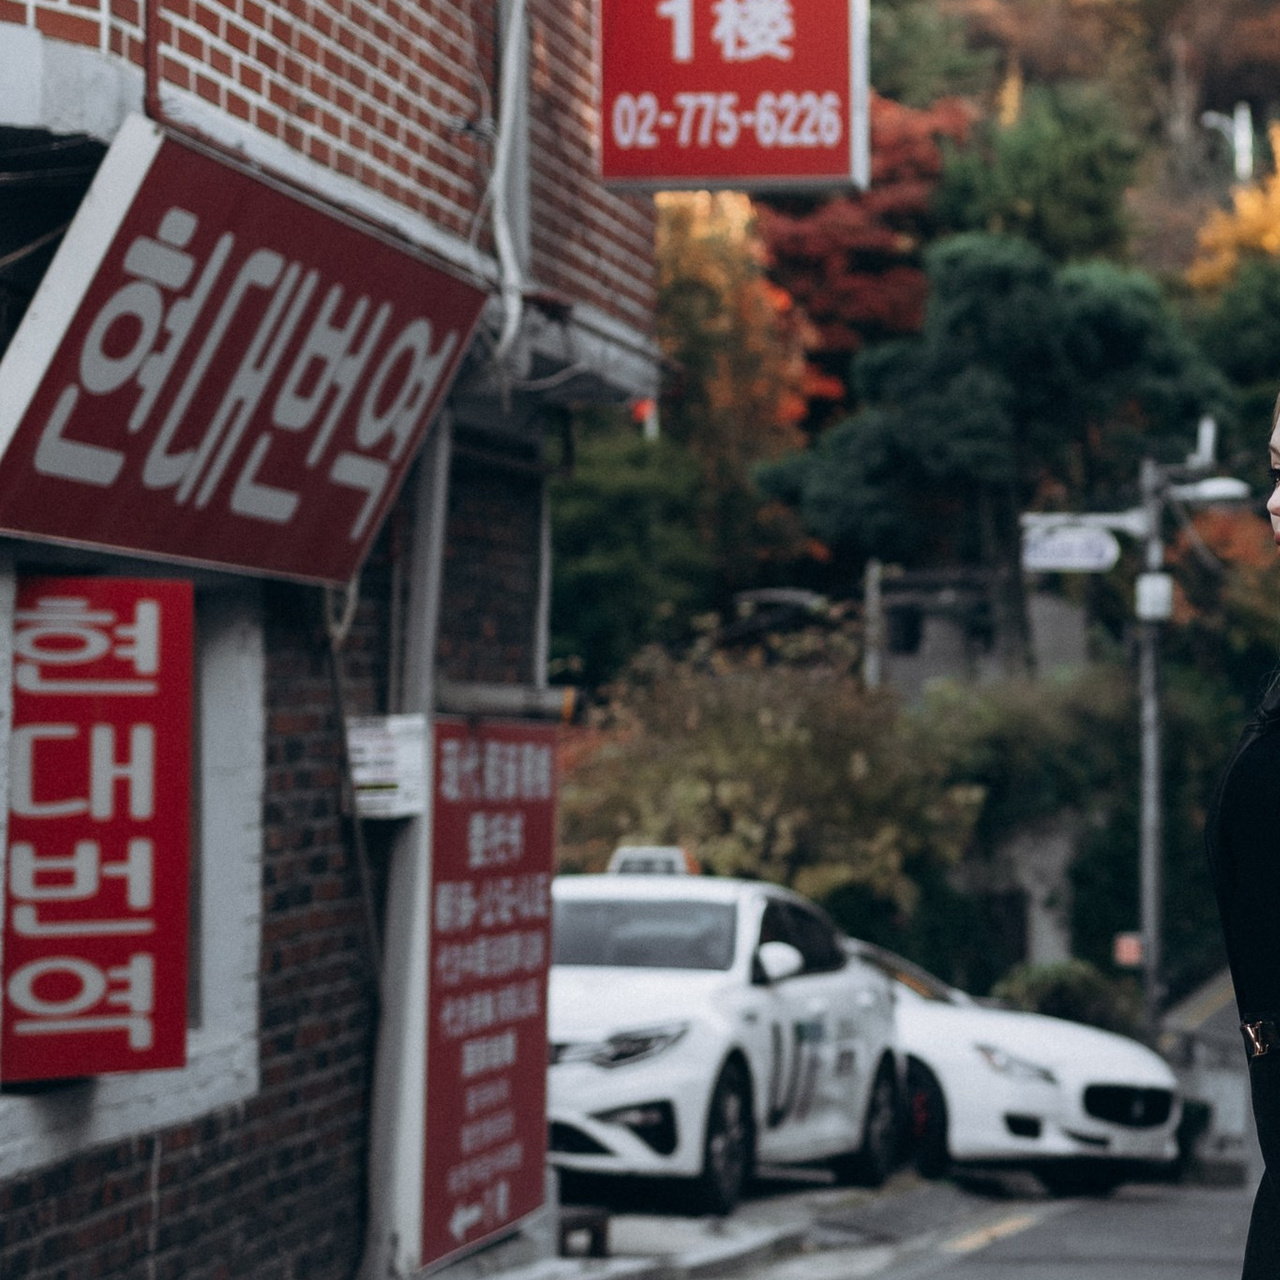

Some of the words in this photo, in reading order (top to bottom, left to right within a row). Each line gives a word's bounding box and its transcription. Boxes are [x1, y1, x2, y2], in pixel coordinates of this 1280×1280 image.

[612, 91, 842, 149] 02-775-6226
[33, 206, 459, 542] 현대번역
[7, 596, 161, 1050] 현대번역
